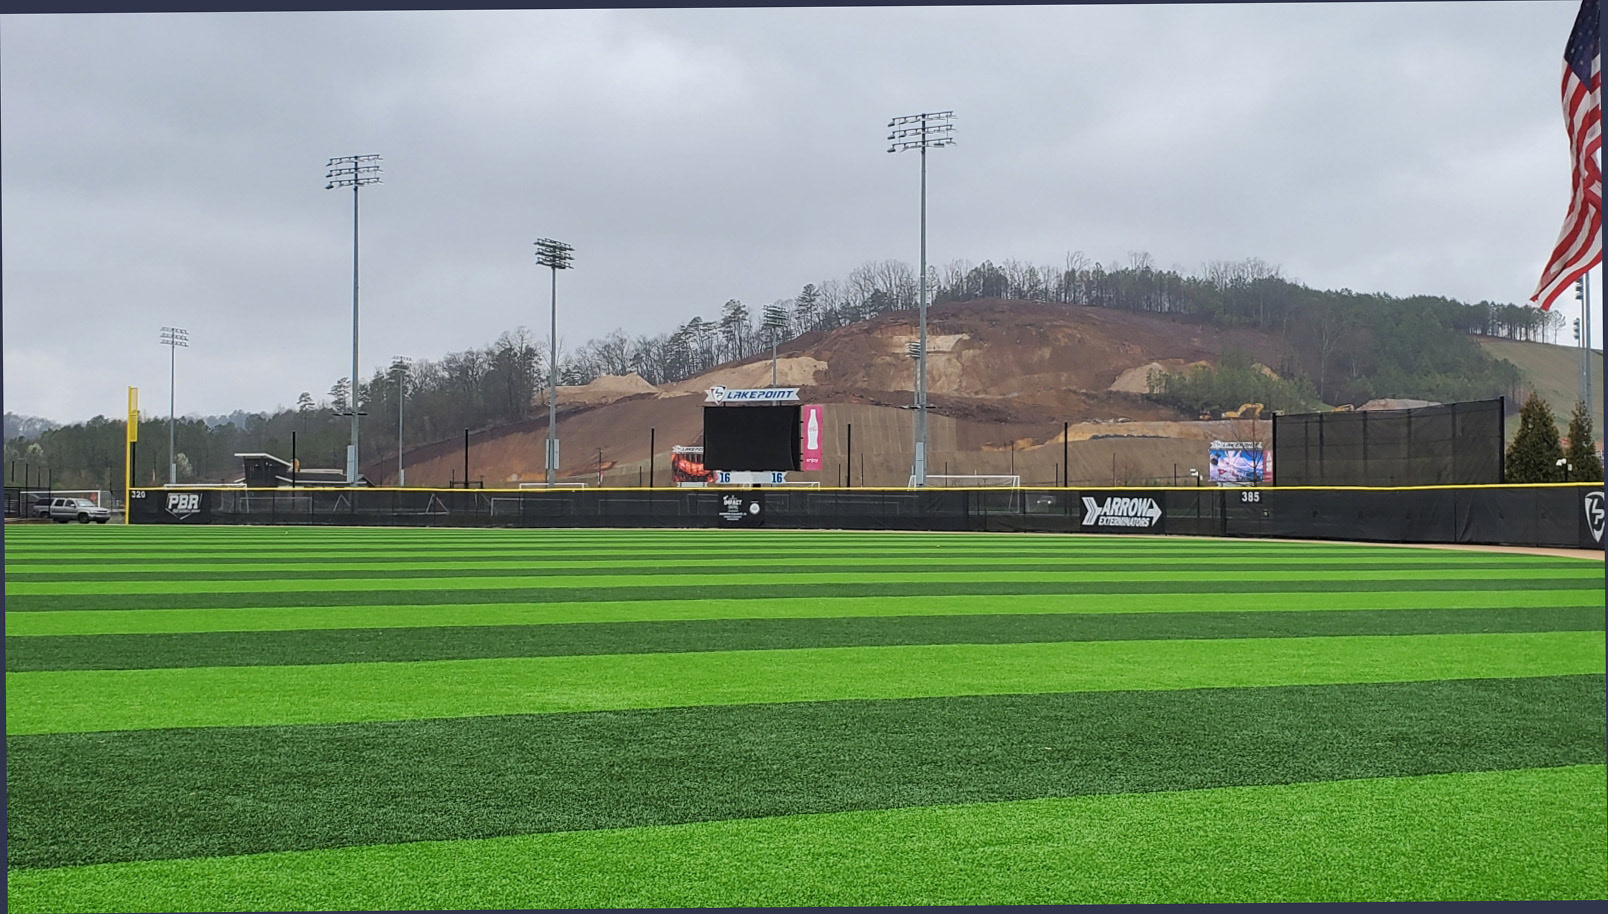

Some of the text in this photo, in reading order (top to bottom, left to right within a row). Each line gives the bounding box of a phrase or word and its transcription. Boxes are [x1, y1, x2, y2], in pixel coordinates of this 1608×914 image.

[727, 390, 794, 399] LAKEPOINT
[720, 473, 731, 483] 16
[772, 473, 783, 483] 16
[131, 490, 146, 499] 320
[1241, 491, 1260, 502] 385
[168, 494, 199, 509] PBR
[1102, 497, 1149, 516] ARROW
[1098, 516, 1150, 527] EXTERMINATORS
